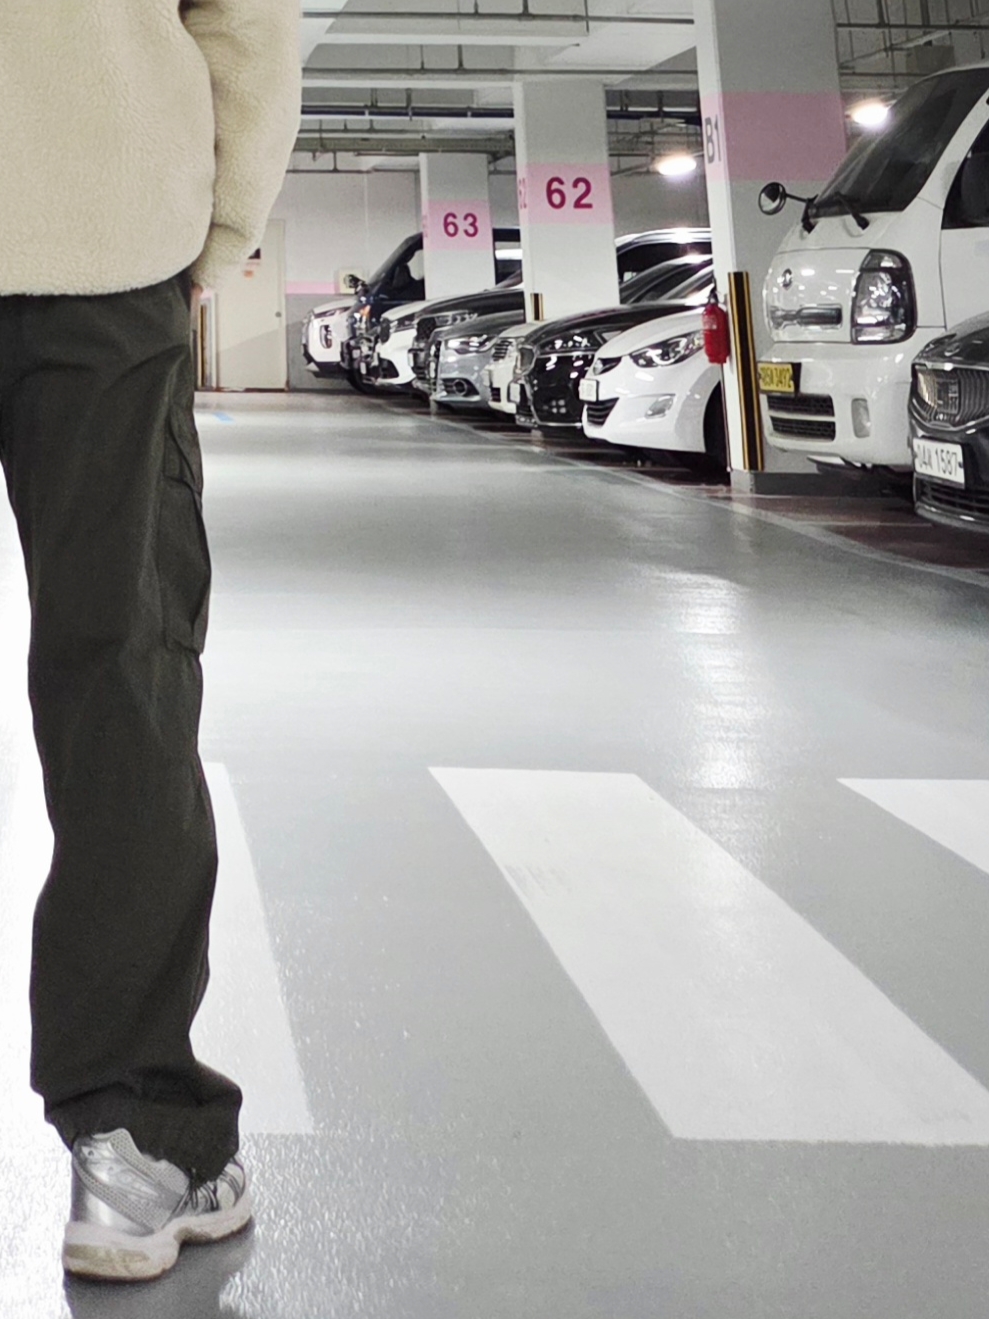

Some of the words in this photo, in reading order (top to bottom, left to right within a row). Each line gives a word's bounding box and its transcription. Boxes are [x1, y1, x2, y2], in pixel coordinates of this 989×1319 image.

[705, 114, 722, 164] B1
[545, 176, 593, 209] 62
[443, 212, 479, 238] 63
